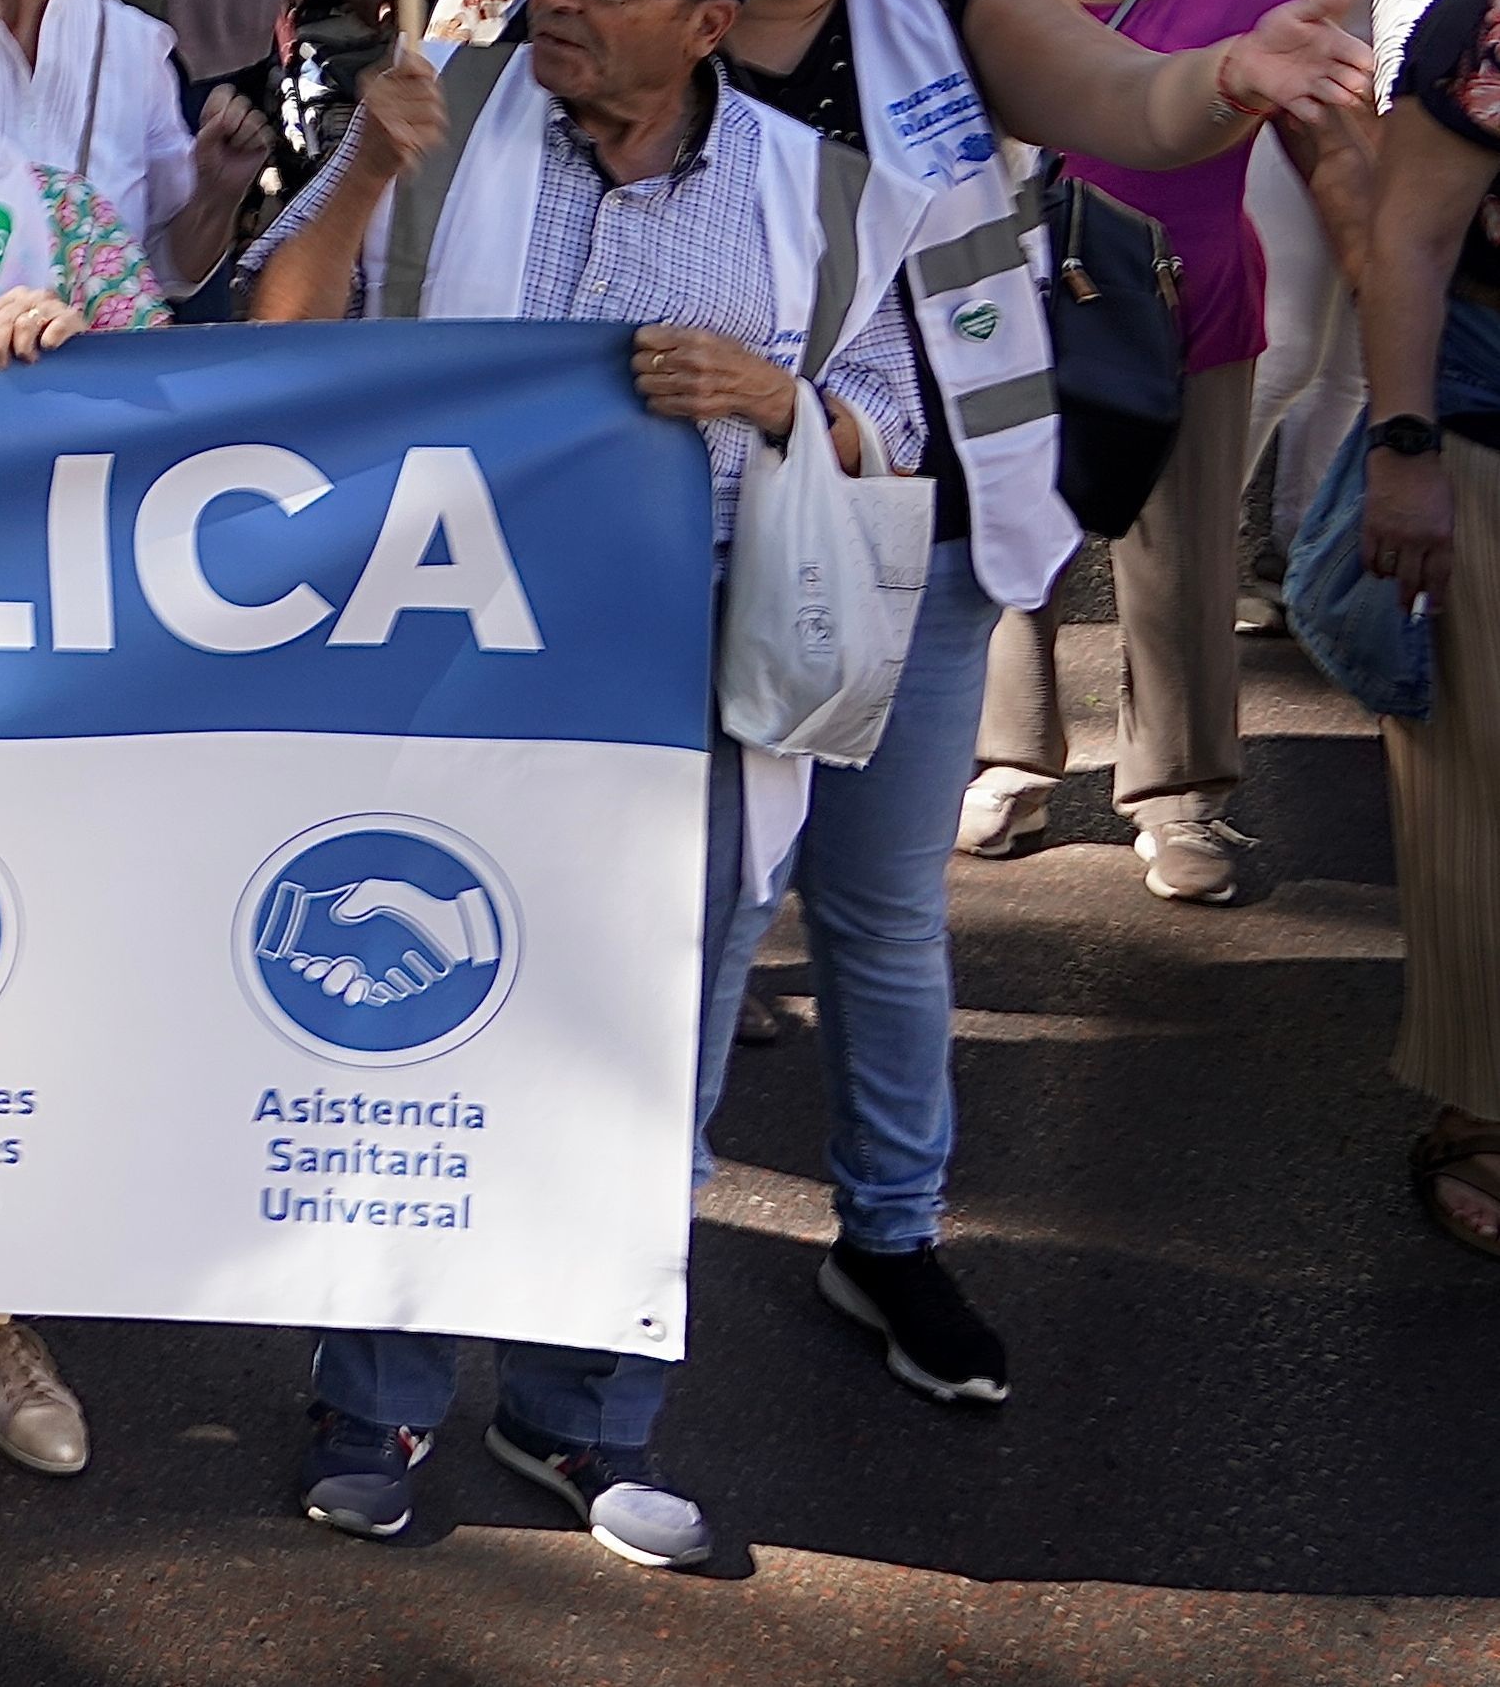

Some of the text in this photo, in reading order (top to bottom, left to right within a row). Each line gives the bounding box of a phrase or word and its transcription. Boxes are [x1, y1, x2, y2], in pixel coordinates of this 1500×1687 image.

[252, 1088, 484, 1129] Asistencia
[266, 1138, 467, 1178] Sanitaria
[260, 1187, 470, 1229] Universal
